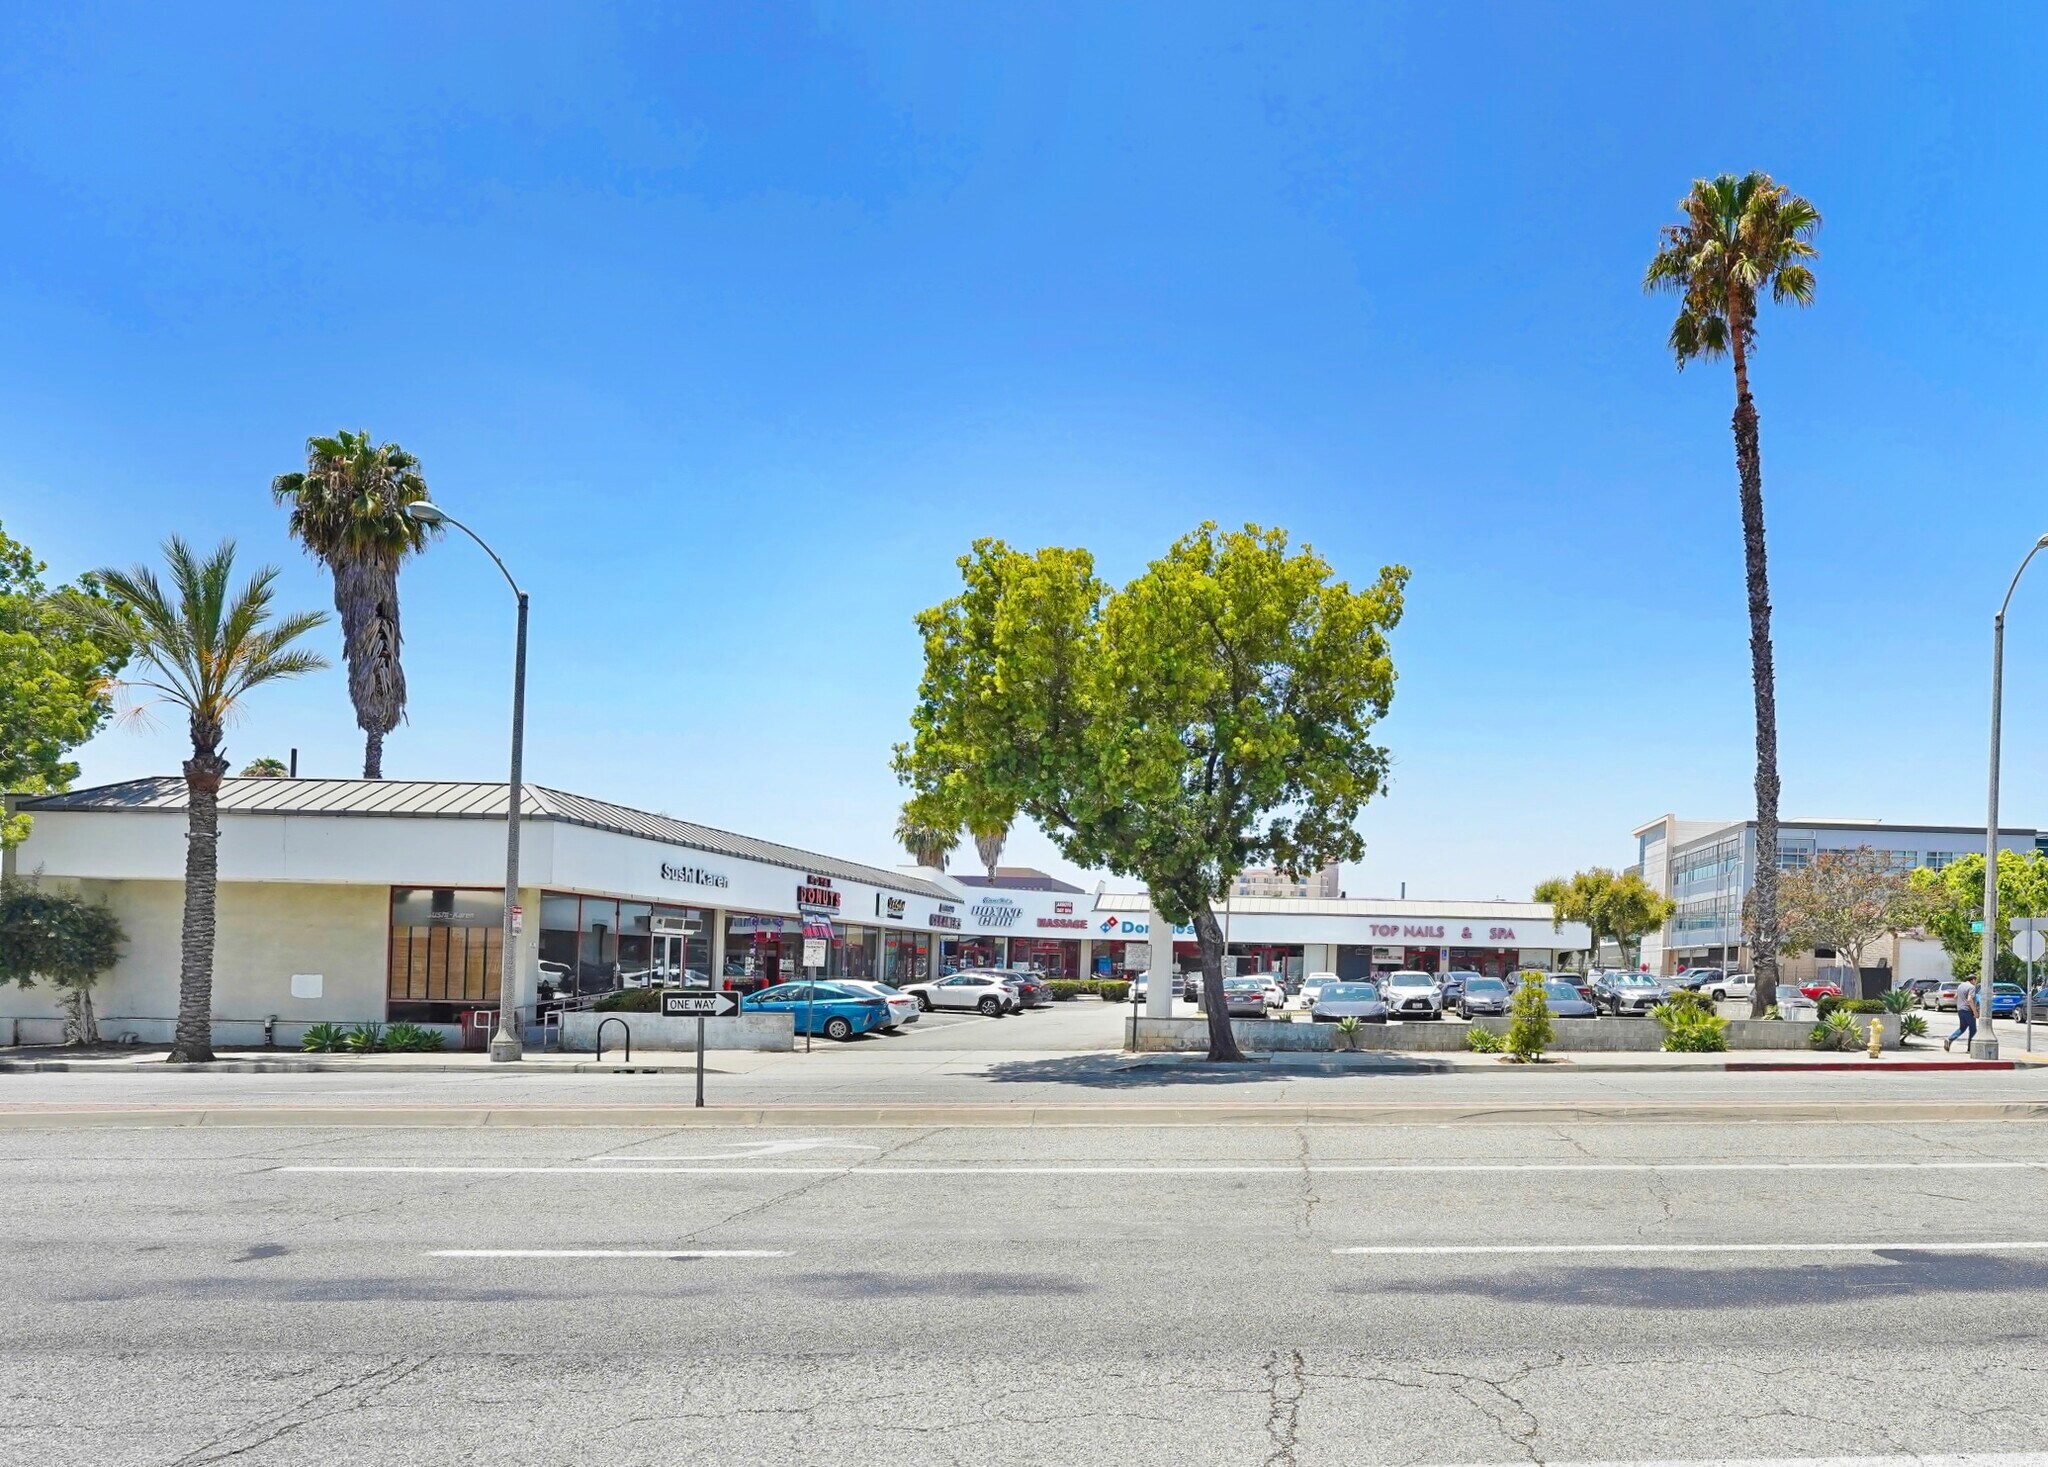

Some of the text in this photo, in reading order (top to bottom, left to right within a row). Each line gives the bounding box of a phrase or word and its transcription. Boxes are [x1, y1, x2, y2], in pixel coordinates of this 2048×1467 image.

[661, 863, 729, 888] Sushi Karen
[797, 886, 842, 907] DONUTS
[971, 906, 1023, 918] BOXING
[978, 917, 1015, 927] CLUB
[1037, 918, 1088, 929] MASSAGE
[1369, 924, 1516, 940] TOP NAILS & SPA
[669, 999, 716, 1010] ONE WAY
